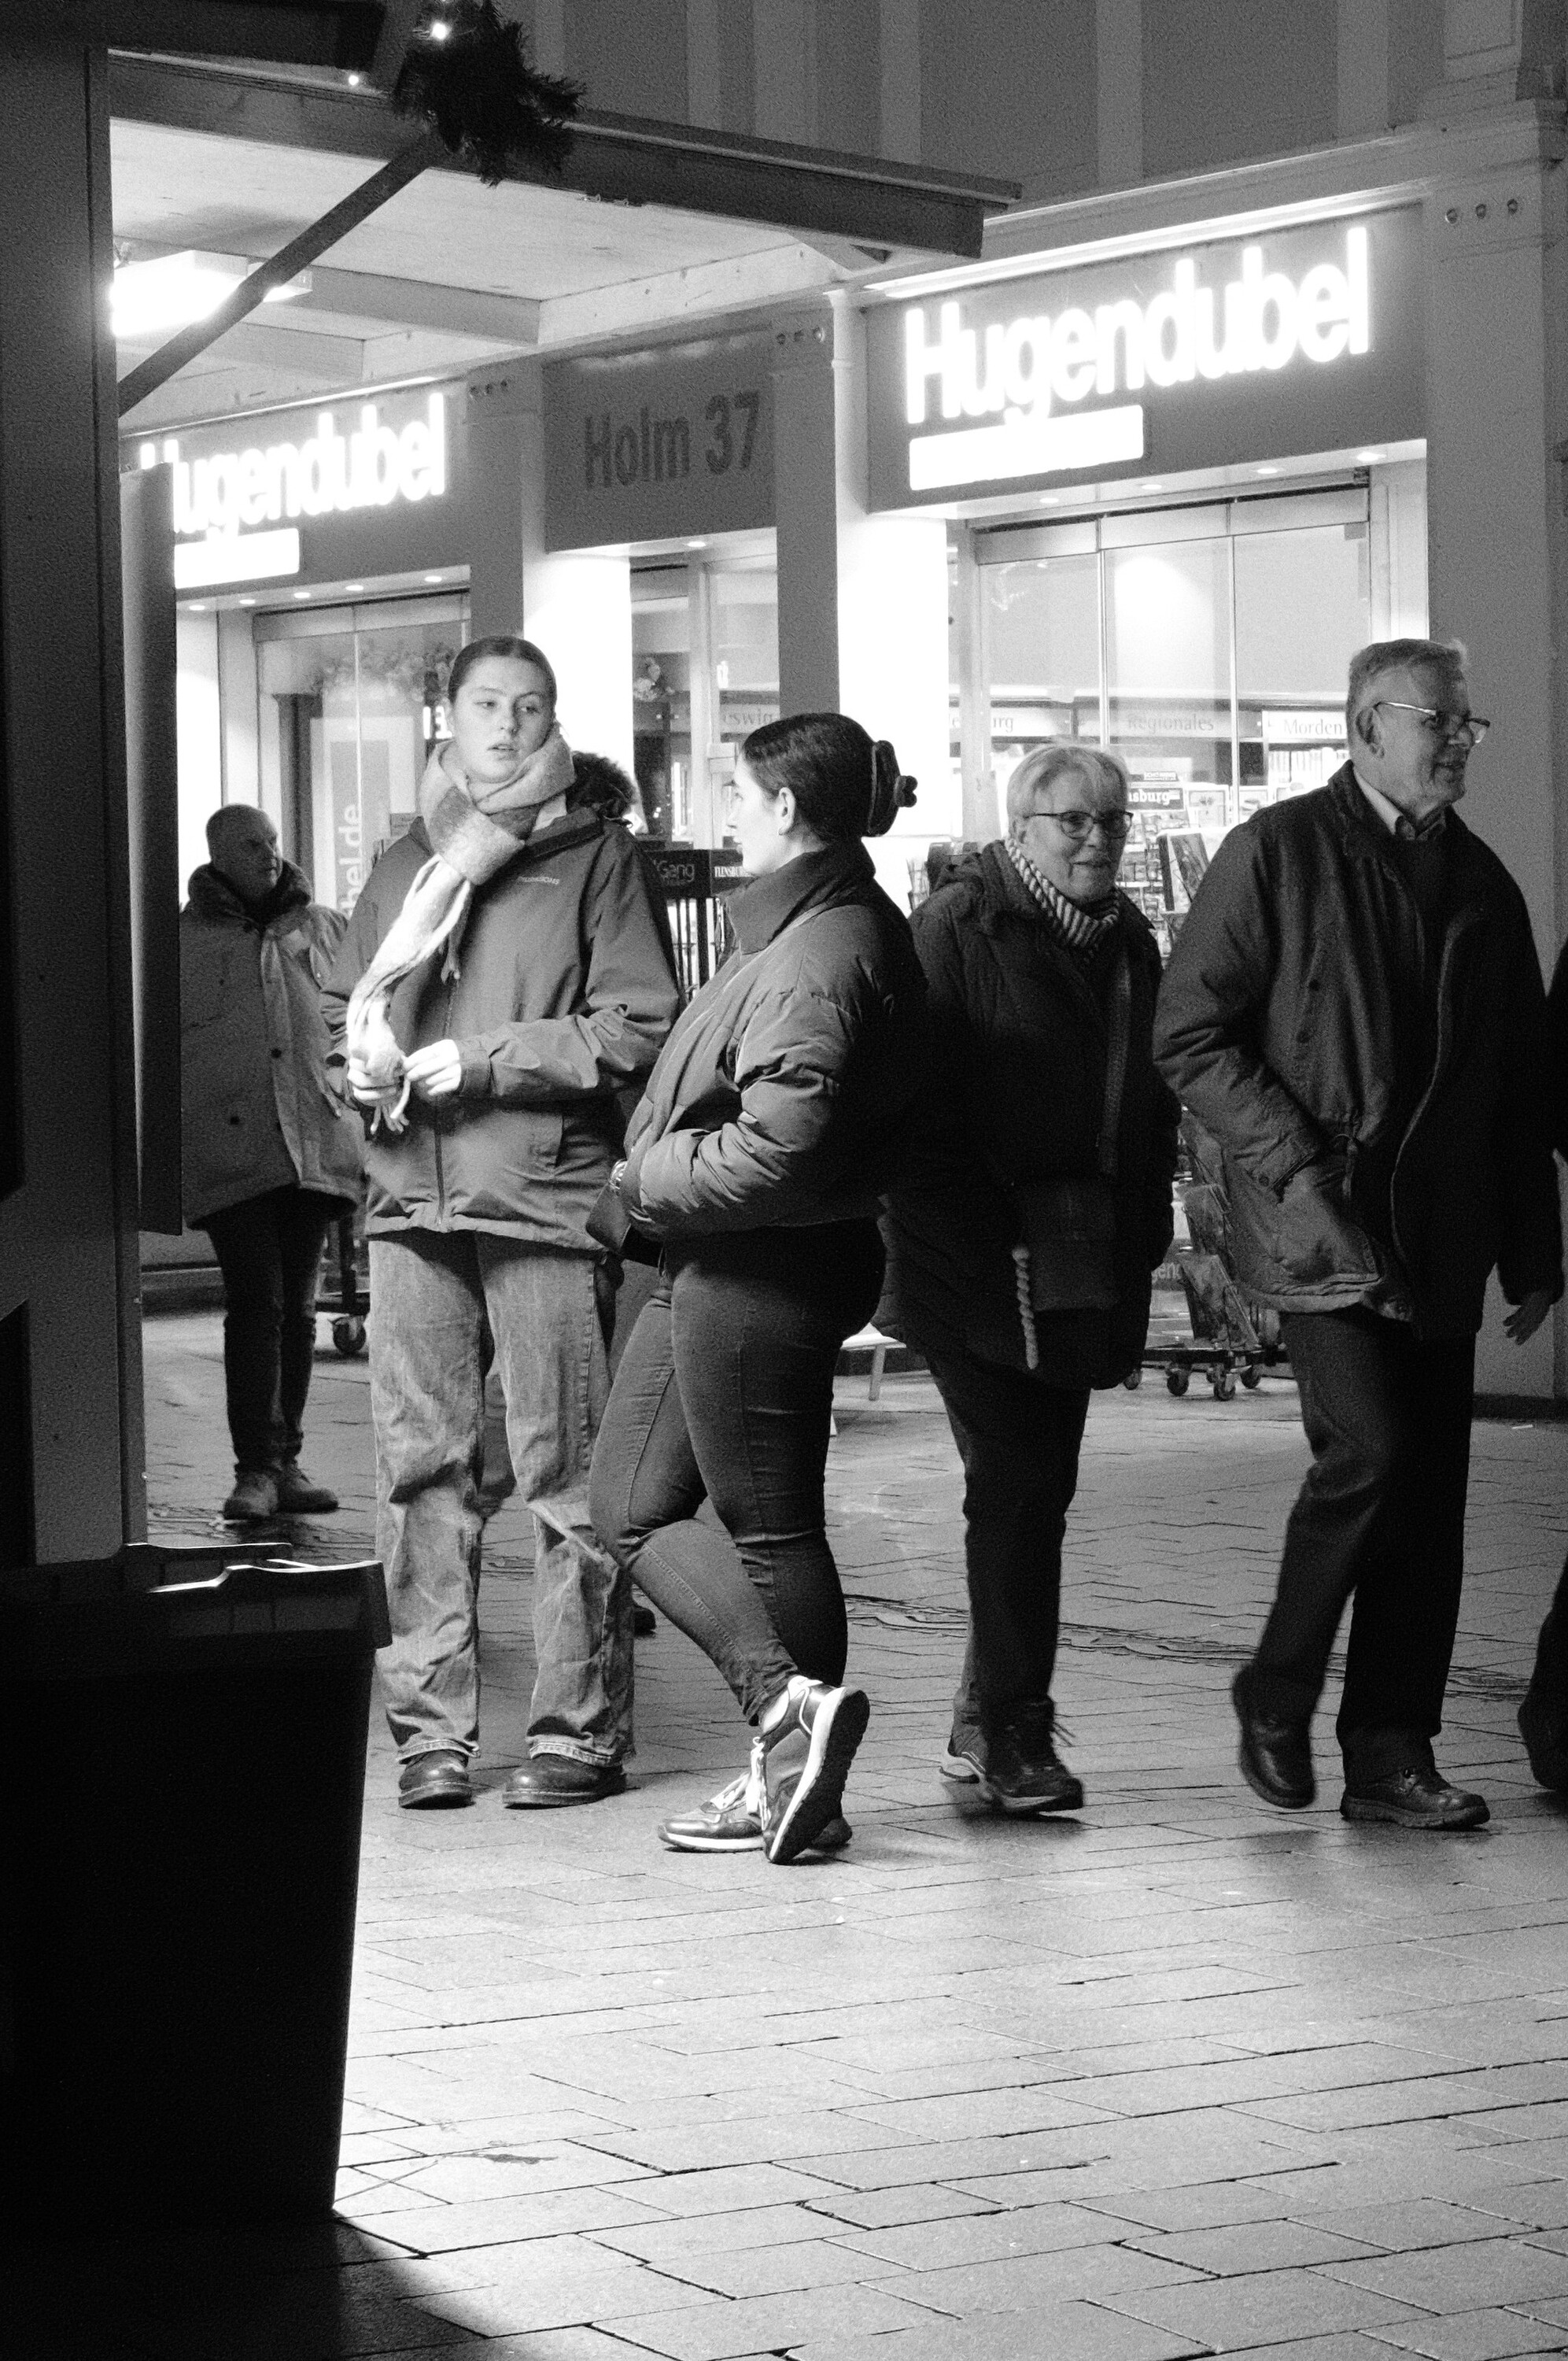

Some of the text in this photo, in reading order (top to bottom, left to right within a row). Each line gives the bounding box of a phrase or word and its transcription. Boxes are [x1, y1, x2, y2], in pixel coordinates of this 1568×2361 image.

[904, 226, 1370, 429] Hugendubel
[585, 390, 760, 490] Holm 37
[1127, 713, 1214, 734] Regionales
